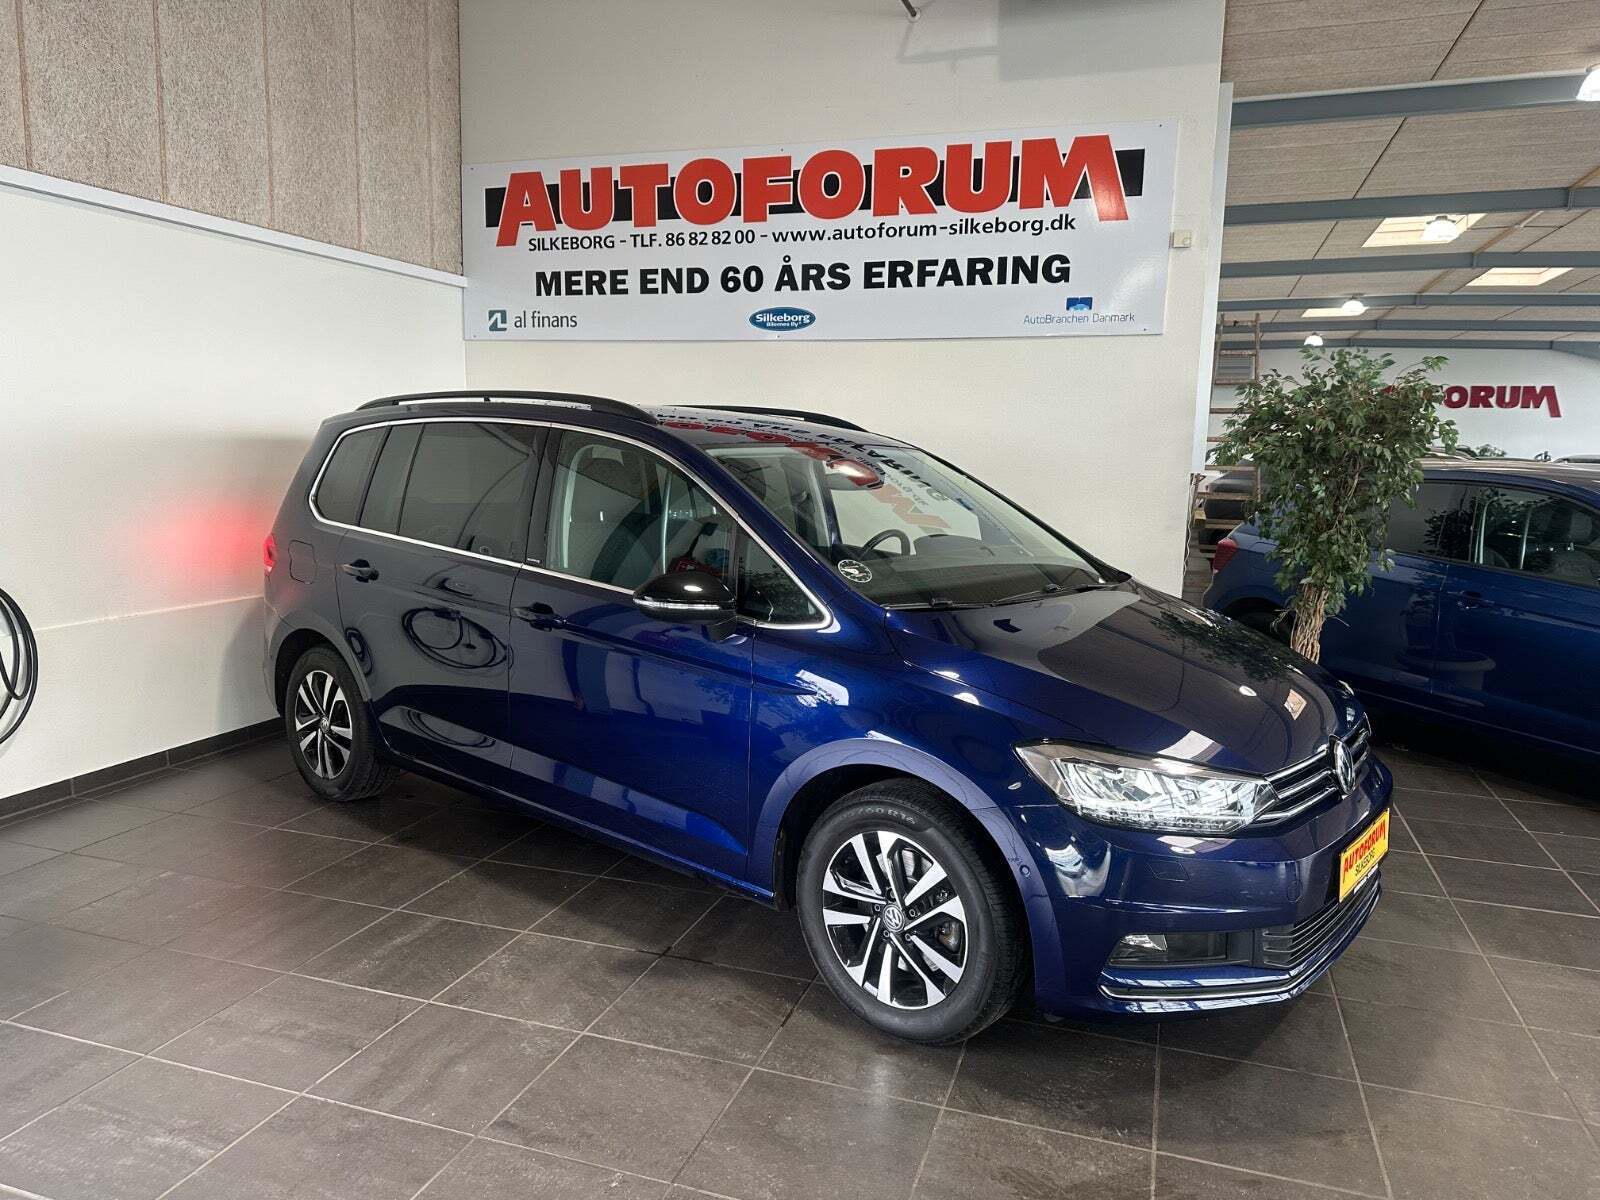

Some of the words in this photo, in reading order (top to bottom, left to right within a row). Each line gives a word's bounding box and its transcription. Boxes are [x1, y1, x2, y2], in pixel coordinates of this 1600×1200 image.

[496, 134, 1129, 247] AUTOFORUM
[528, 234, 615, 251] SILKEBORG
[630, 233, 662, 248] TLF.
[772, 213, 1076, 243] www.autoforum-silkeborg.dk
[535, 269, 629, 297] MERE
[639, 267, 710, 295] END
[720, 265, 764, 293] 60
[774, 254, 851, 292] ÅRS
[863, 253, 1071, 290] ERFARING
[514, 310, 527, 328] al
[531, 310, 578, 328] finans
[755, 312, 811, 324] Silkeborg
[1023, 314, 1089, 325] AutoBranchen
[1092, 312, 1135, 324] Danmark
[1342, 819, 1386, 884] AUTOFORUM
